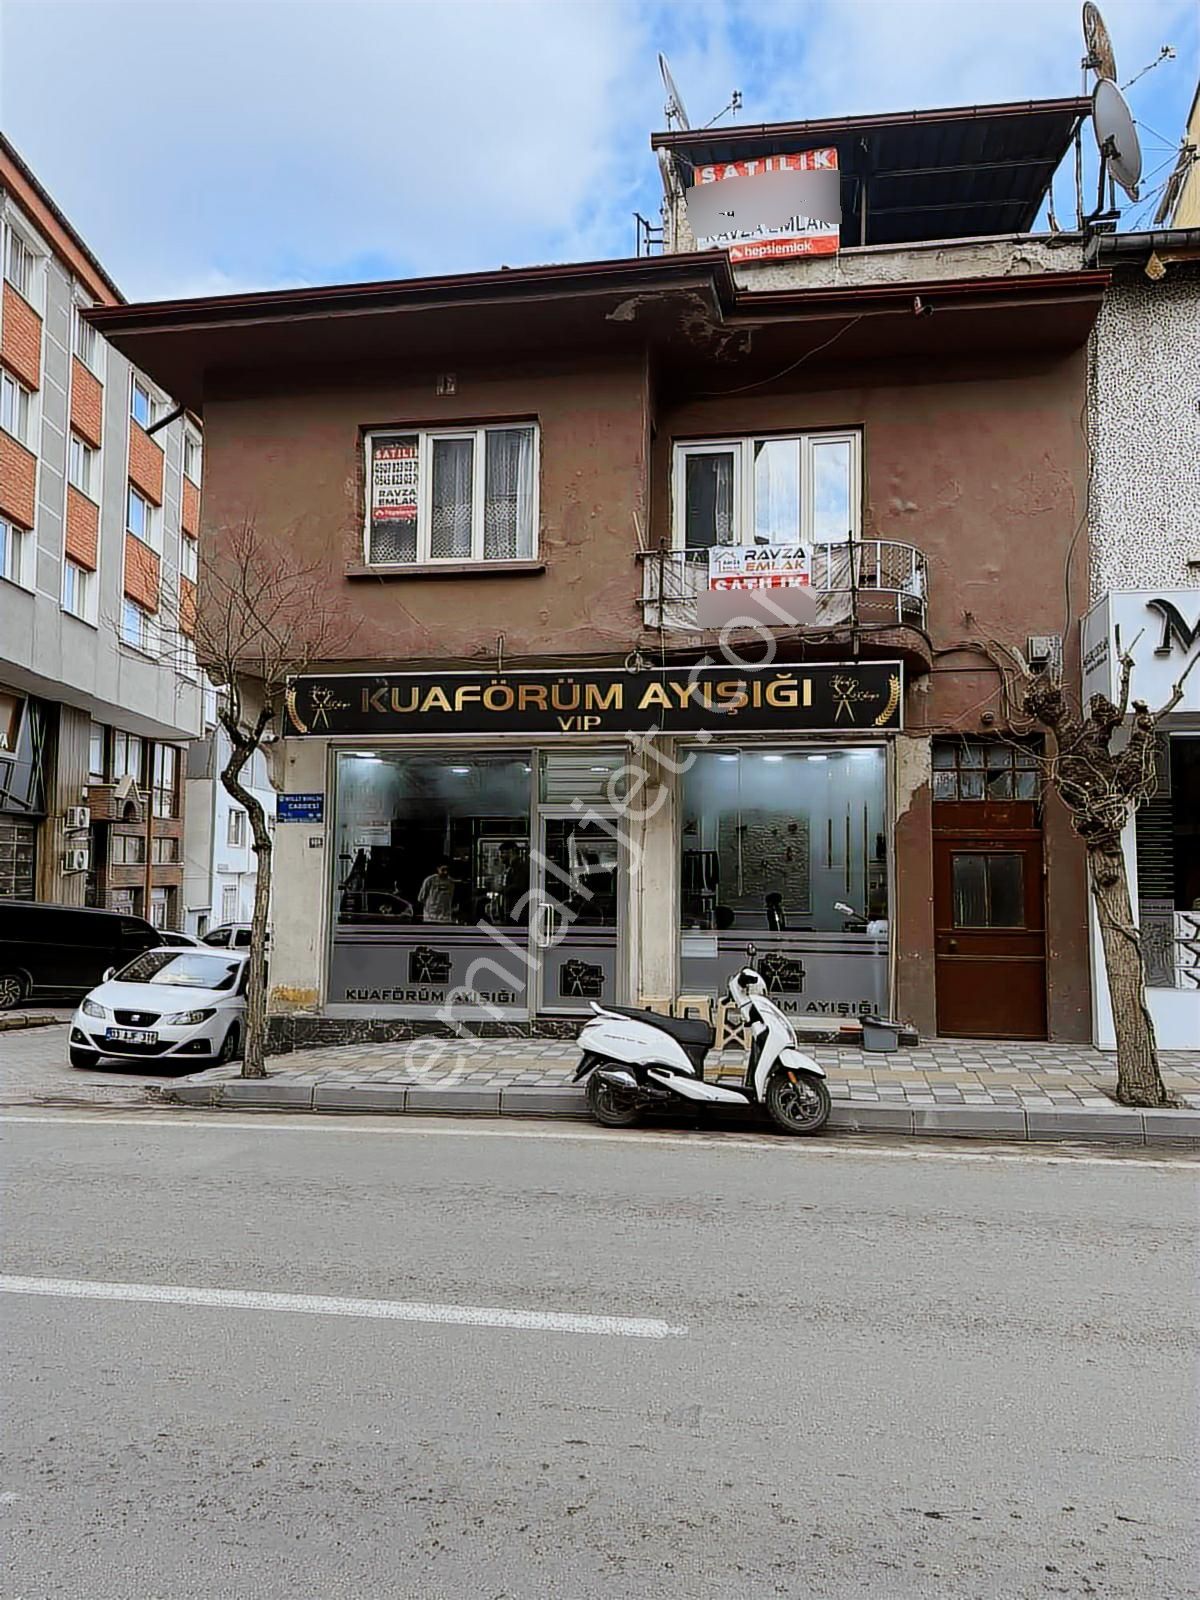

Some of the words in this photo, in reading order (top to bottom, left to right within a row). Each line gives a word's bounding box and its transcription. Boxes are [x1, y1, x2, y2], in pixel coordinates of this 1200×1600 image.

[701, 150, 832, 185] SATILIK
[744, 240, 813, 257] hepsiemlak
[744, 548, 806, 561] RAVZA
[745, 560, 804, 571] EMLAK
[361, 678, 623, 713] KUAFÖRÜM
[638, 673, 812, 715] AYIŞIĞI
[557, 715, 601, 731] VIP
[346, 987, 444, 1002] KUAFÖRÜM
